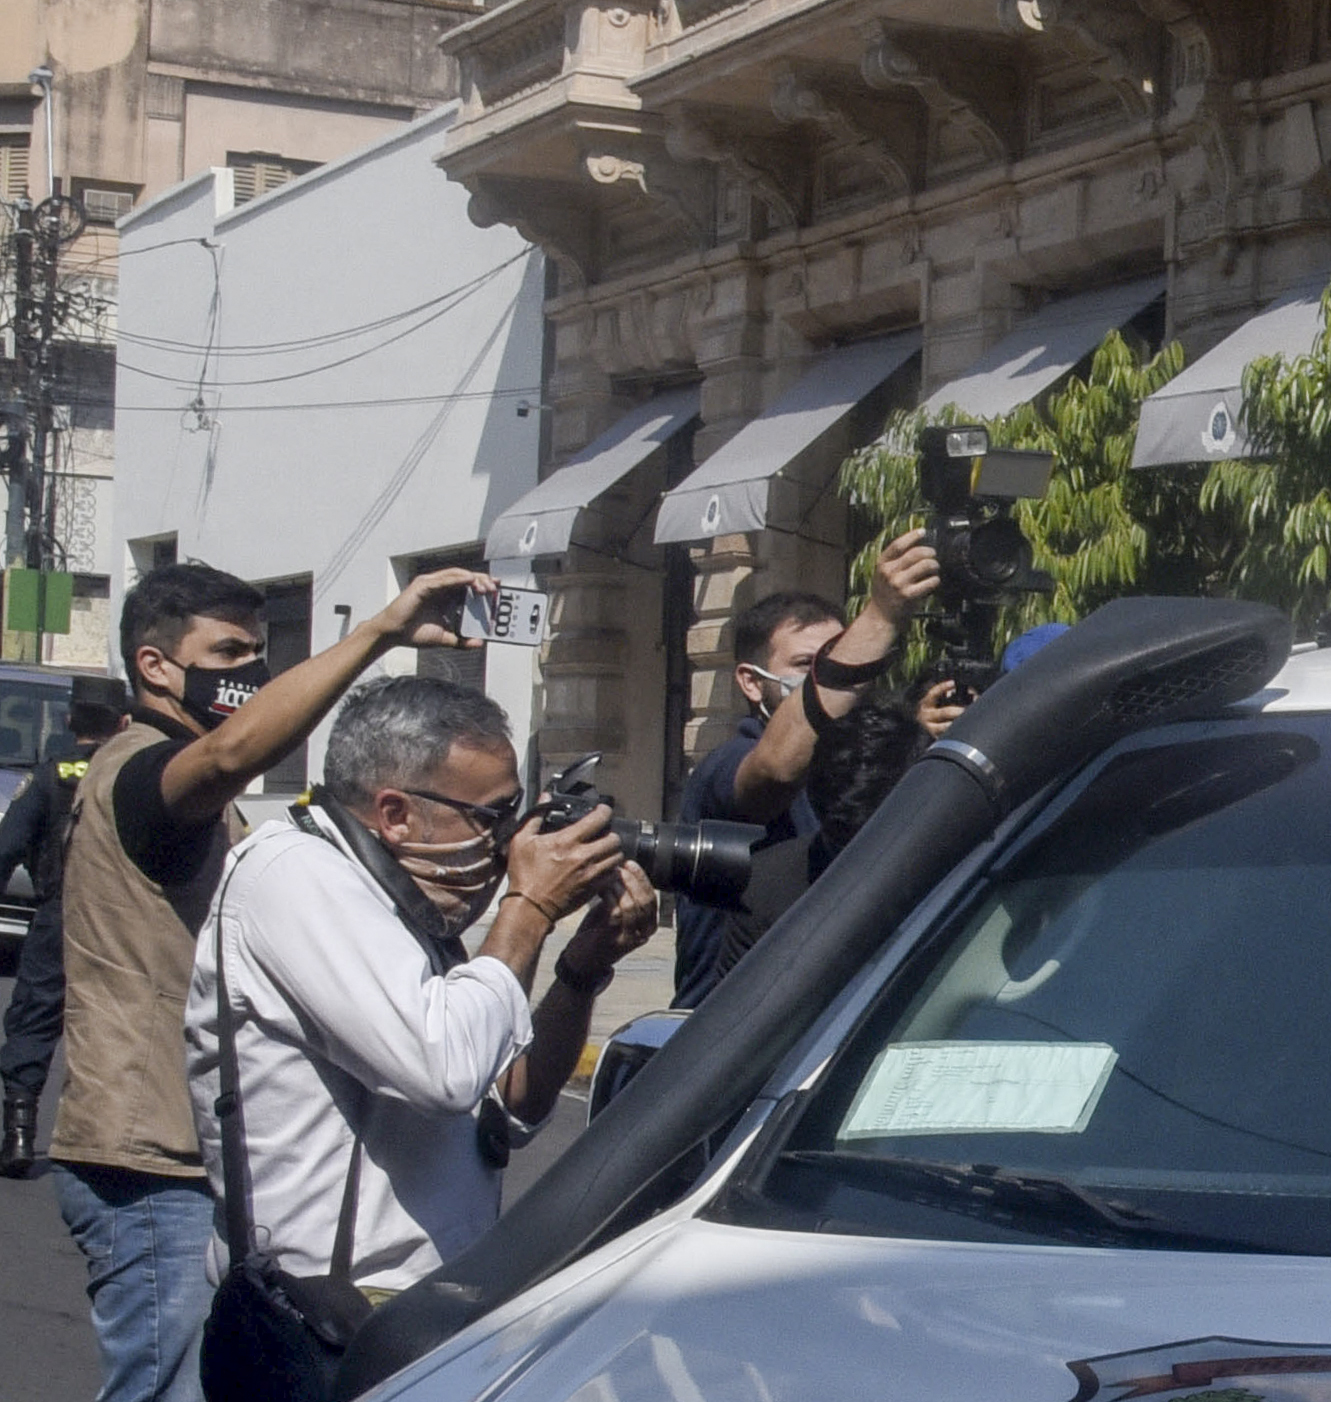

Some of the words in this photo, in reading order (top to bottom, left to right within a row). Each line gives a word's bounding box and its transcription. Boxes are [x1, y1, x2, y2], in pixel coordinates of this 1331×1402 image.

[495, 592, 514, 637] 1000
[219, 679, 259, 693] RADIO
[215, 687, 253, 708] 100
